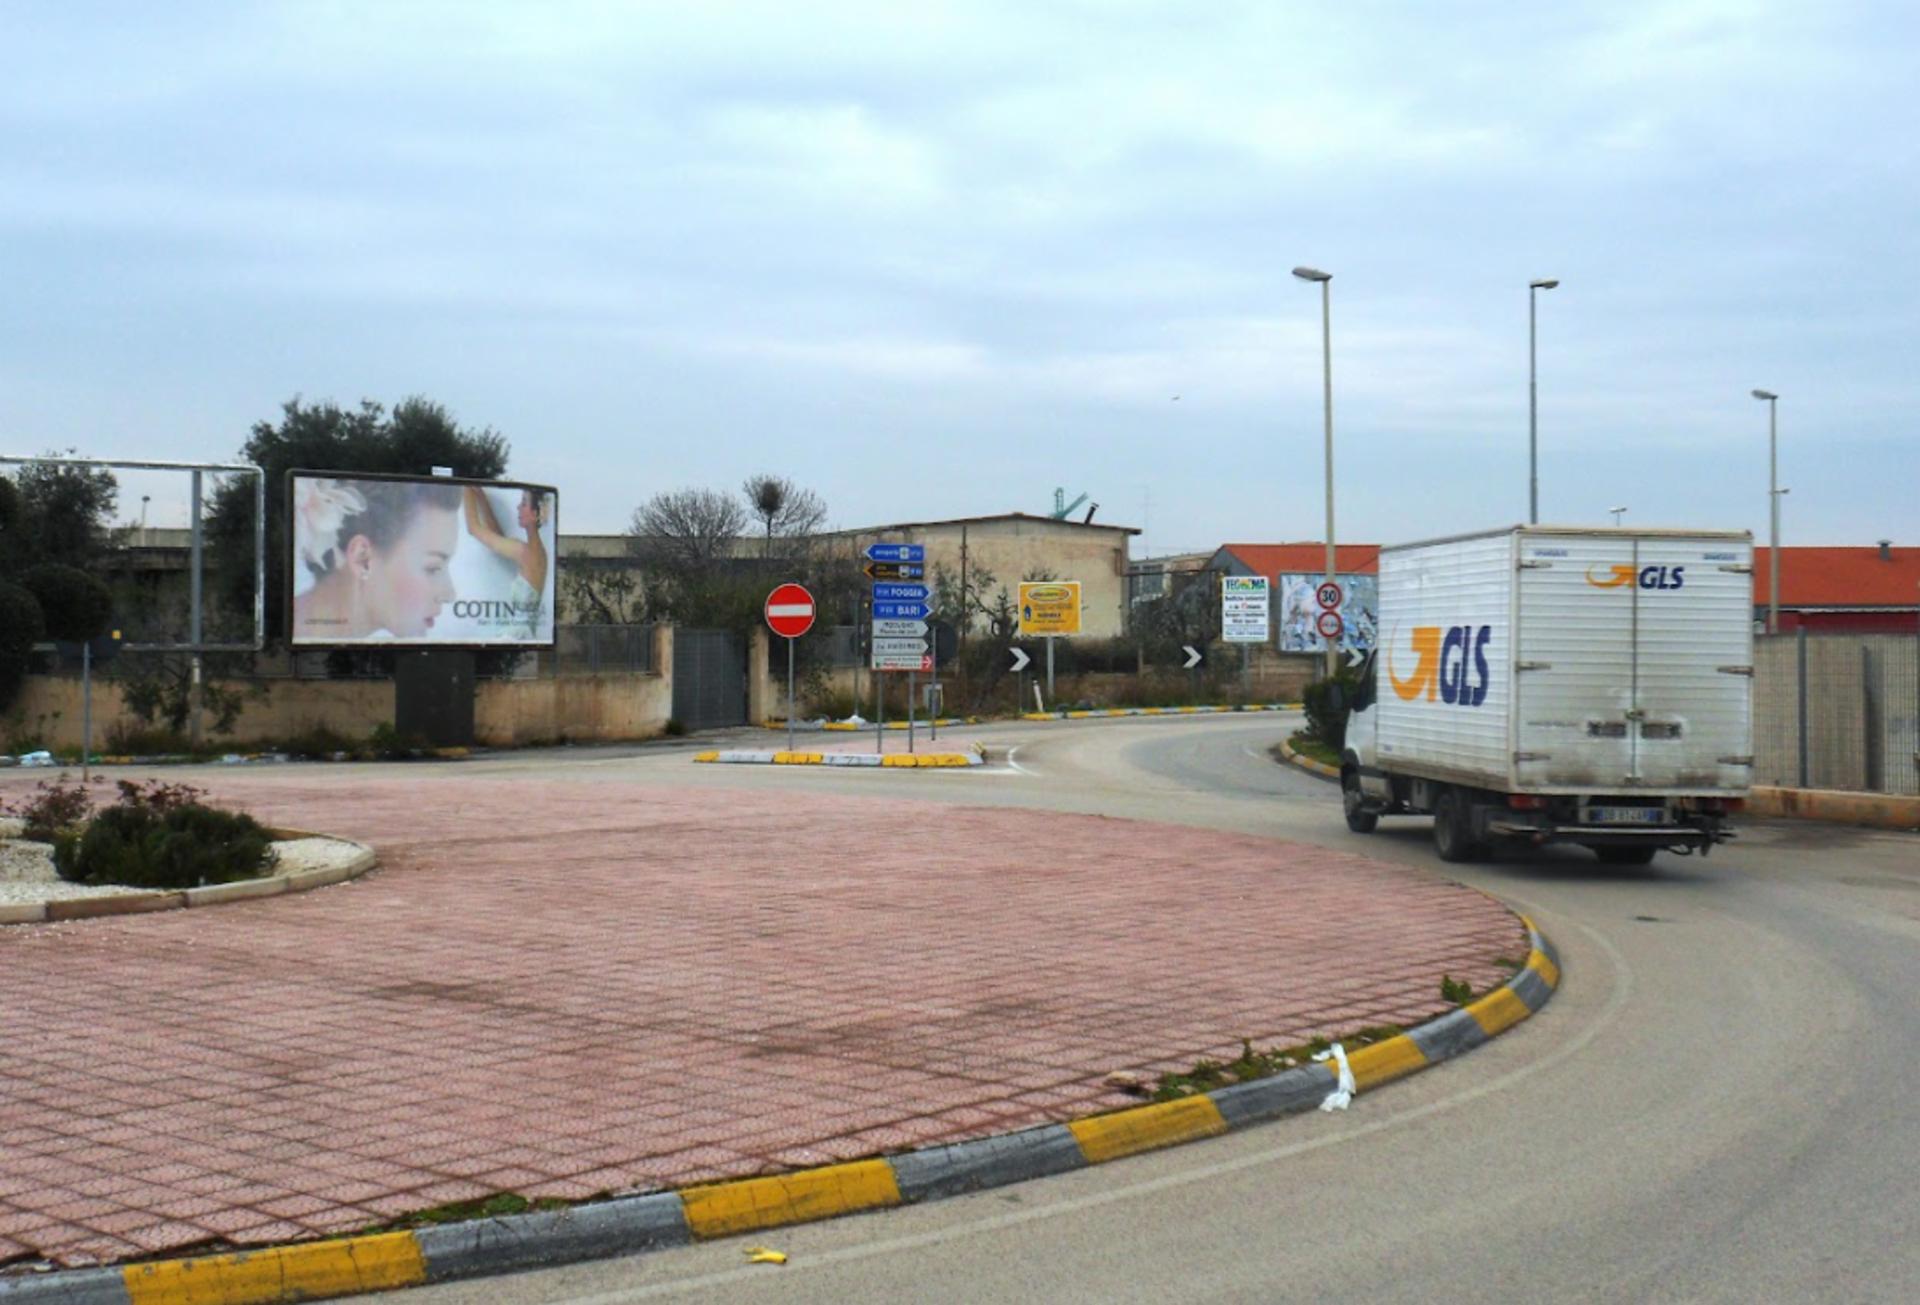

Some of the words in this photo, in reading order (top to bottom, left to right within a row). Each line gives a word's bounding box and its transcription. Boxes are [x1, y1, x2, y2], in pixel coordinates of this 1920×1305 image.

[1639, 566, 1684, 590] GLS
[1322, 589, 1337, 602] 30
[897, 604, 920, 616] BARI
[1440, 625, 1491, 707] GLS
